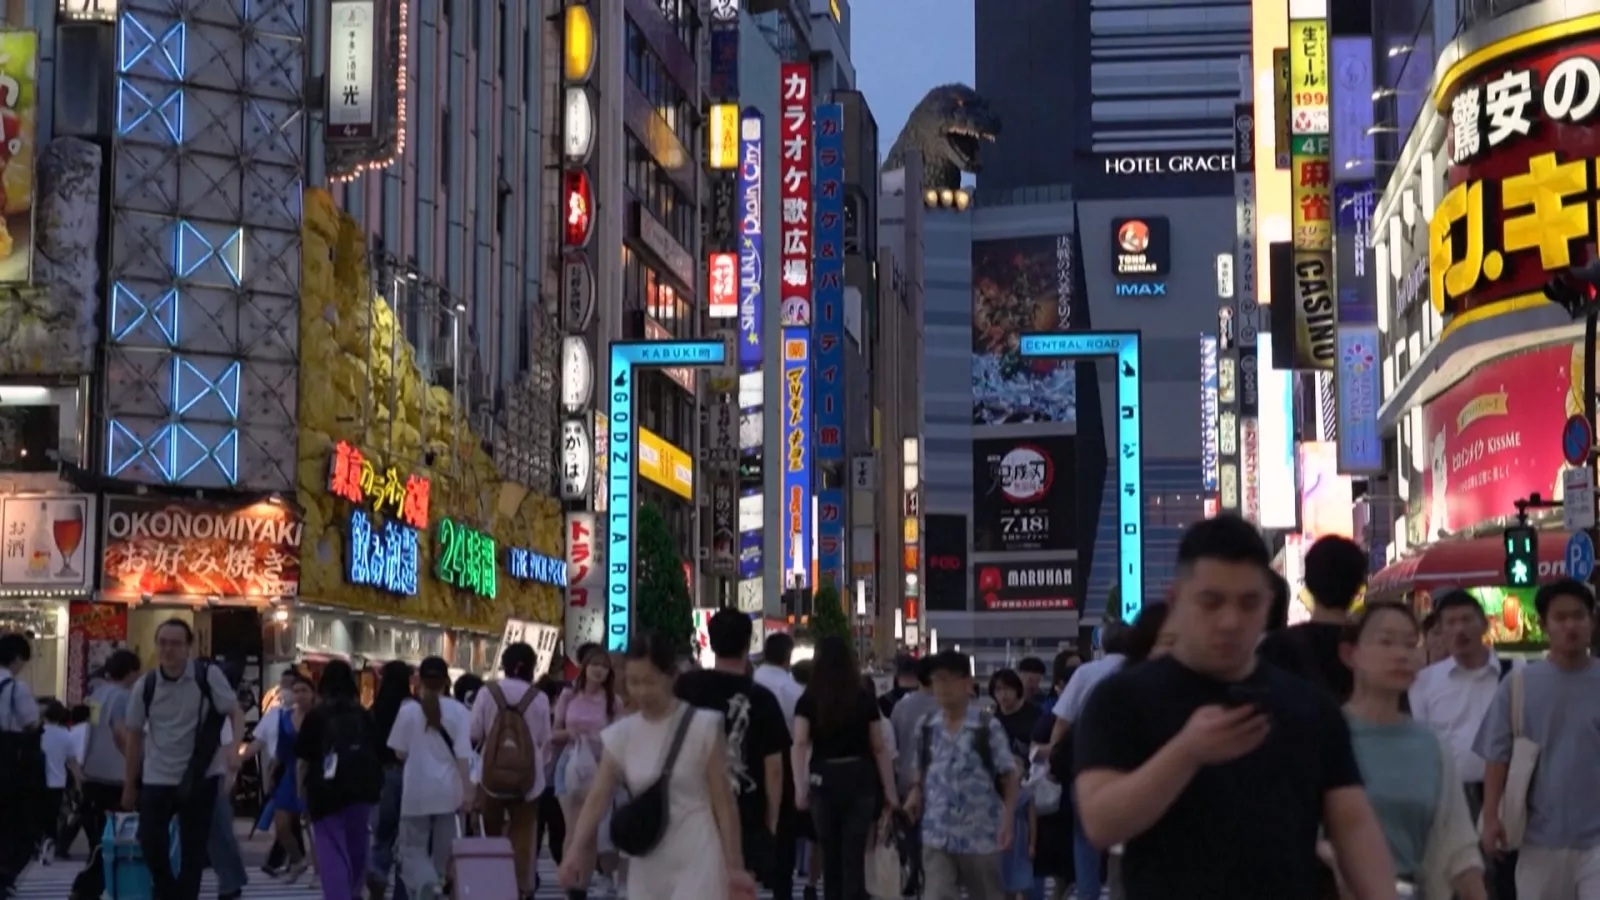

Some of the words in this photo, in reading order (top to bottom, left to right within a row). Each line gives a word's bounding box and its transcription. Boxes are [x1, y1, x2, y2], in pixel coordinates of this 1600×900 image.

[1302, 26, 1318, 86] 生ビール
[342, 85, 359, 105] 光
[1295, 92, 1328, 106] 199
[1451, 56, 1600, 163] 驚安の
[783, 72, 807, 286] カラオケ歌広場
[1105, 157, 1164, 174] HOTEL
[1168, 153, 1236, 173] GRACE
[1429, 152, 1600, 313] ドン.キ
[1118, 263, 1157, 273] CINEMAS
[741, 247, 760, 333] SHINJUKU
[1115, 283, 1166, 296] IMAX
[1025, 339, 1083, 350] CENTRAL
[1086, 337, 1120, 349] ROAD
[612, 390, 629, 545] GODZILLA
[7, 521, 26, 559] お酒
[108, 511, 302, 546] OKONOMIYAKI
[821, 505, 838, 578] カラ
[1000, 516, 1043, 533] 7.18
[120, 542, 284, 581] お好み焼き
[351, 508, 417, 595] 飲み放題
[438, 517, 497, 600] 24時間
[1007, 568, 1072, 587] MARUHAN
[611, 562, 627, 636] ROAD
